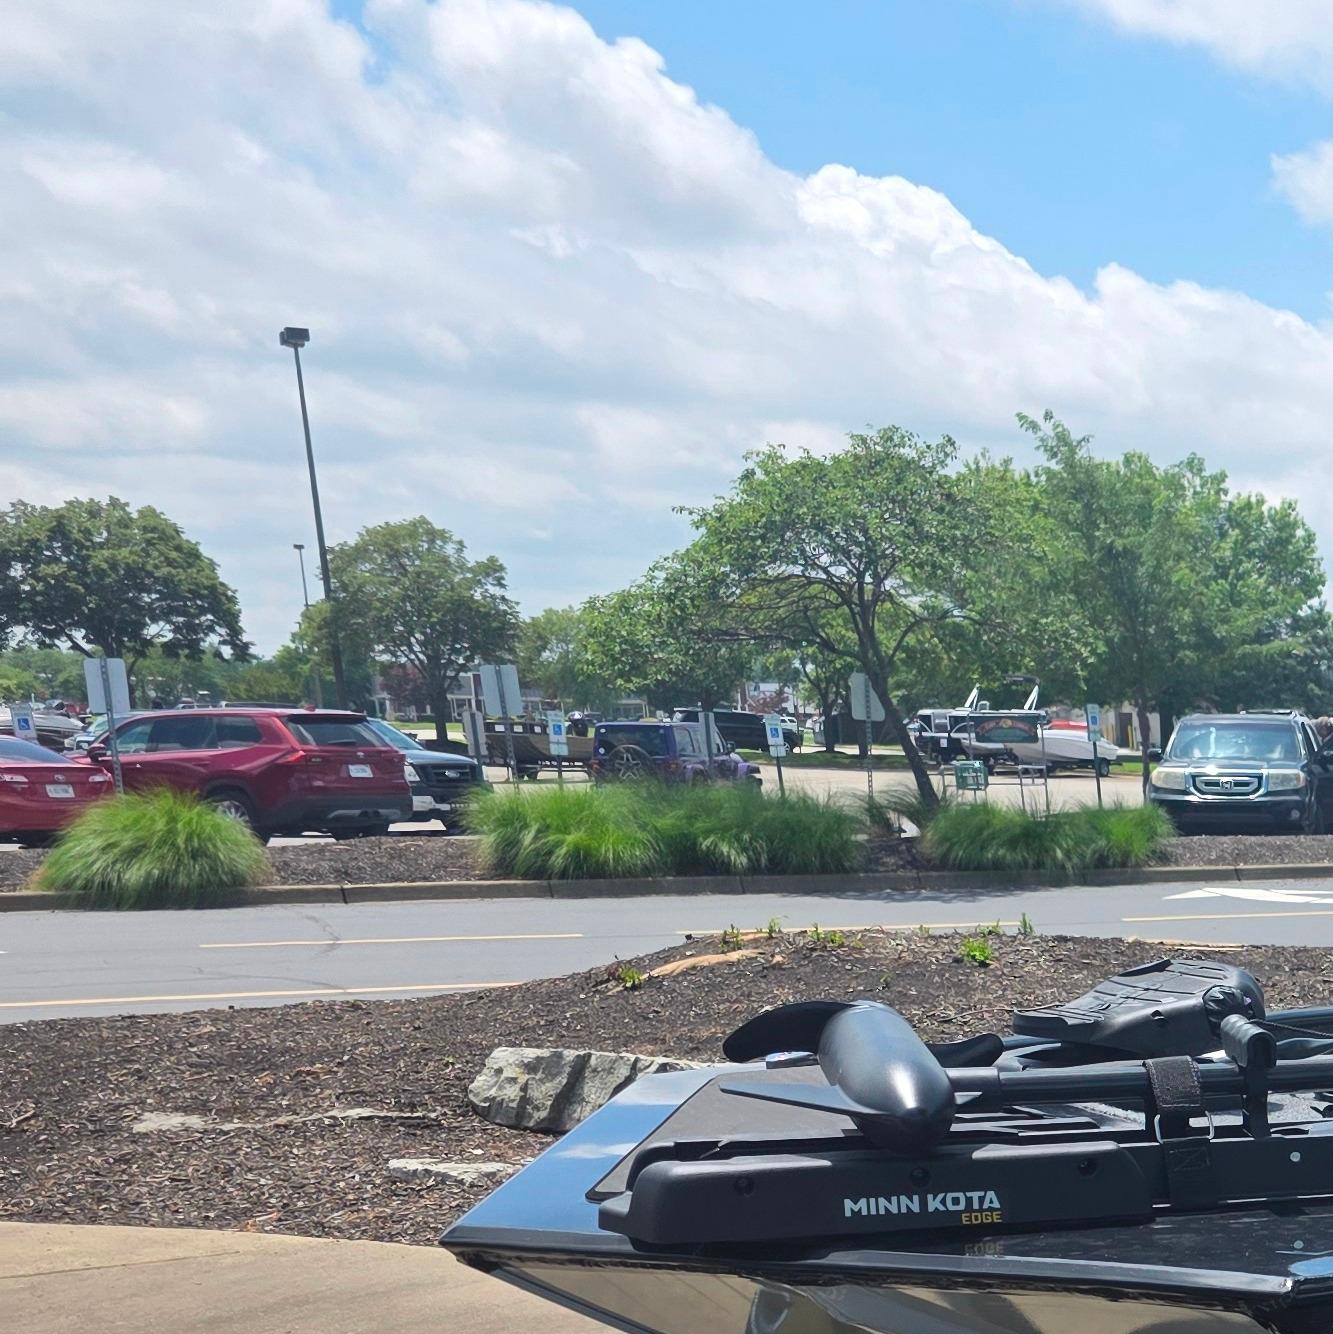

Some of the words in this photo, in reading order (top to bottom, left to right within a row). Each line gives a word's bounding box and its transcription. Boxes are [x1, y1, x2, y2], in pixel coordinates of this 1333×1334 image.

[844, 1195, 921, 1217] MINN
[926, 1190, 1001, 1213] KOTA
[961, 1211, 1003, 1225] EDGE
